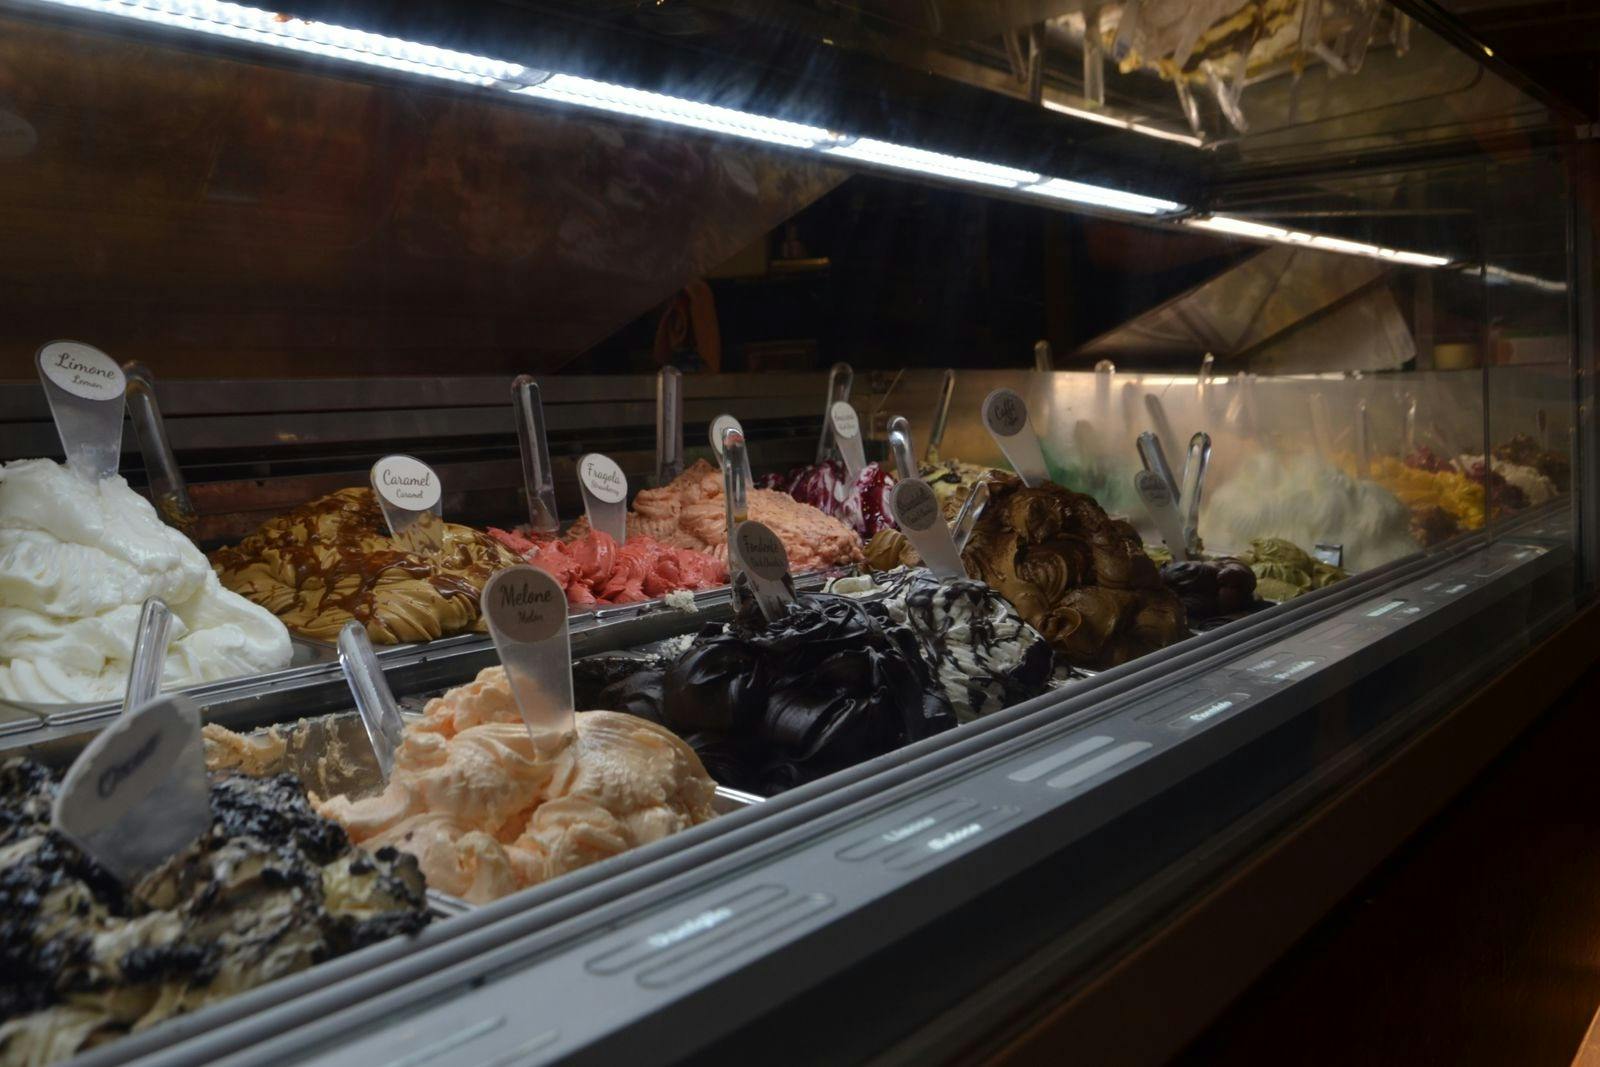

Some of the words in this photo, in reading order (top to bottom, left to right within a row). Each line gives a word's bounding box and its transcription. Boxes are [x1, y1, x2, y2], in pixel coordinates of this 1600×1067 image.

[54, 352, 115, 379] Limone
[382, 469, 432, 487] Caramel
[587, 462, 621, 485] Fragola
[396, 488, 424, 498] Caramel
[501, 583, 553, 607] Melone
